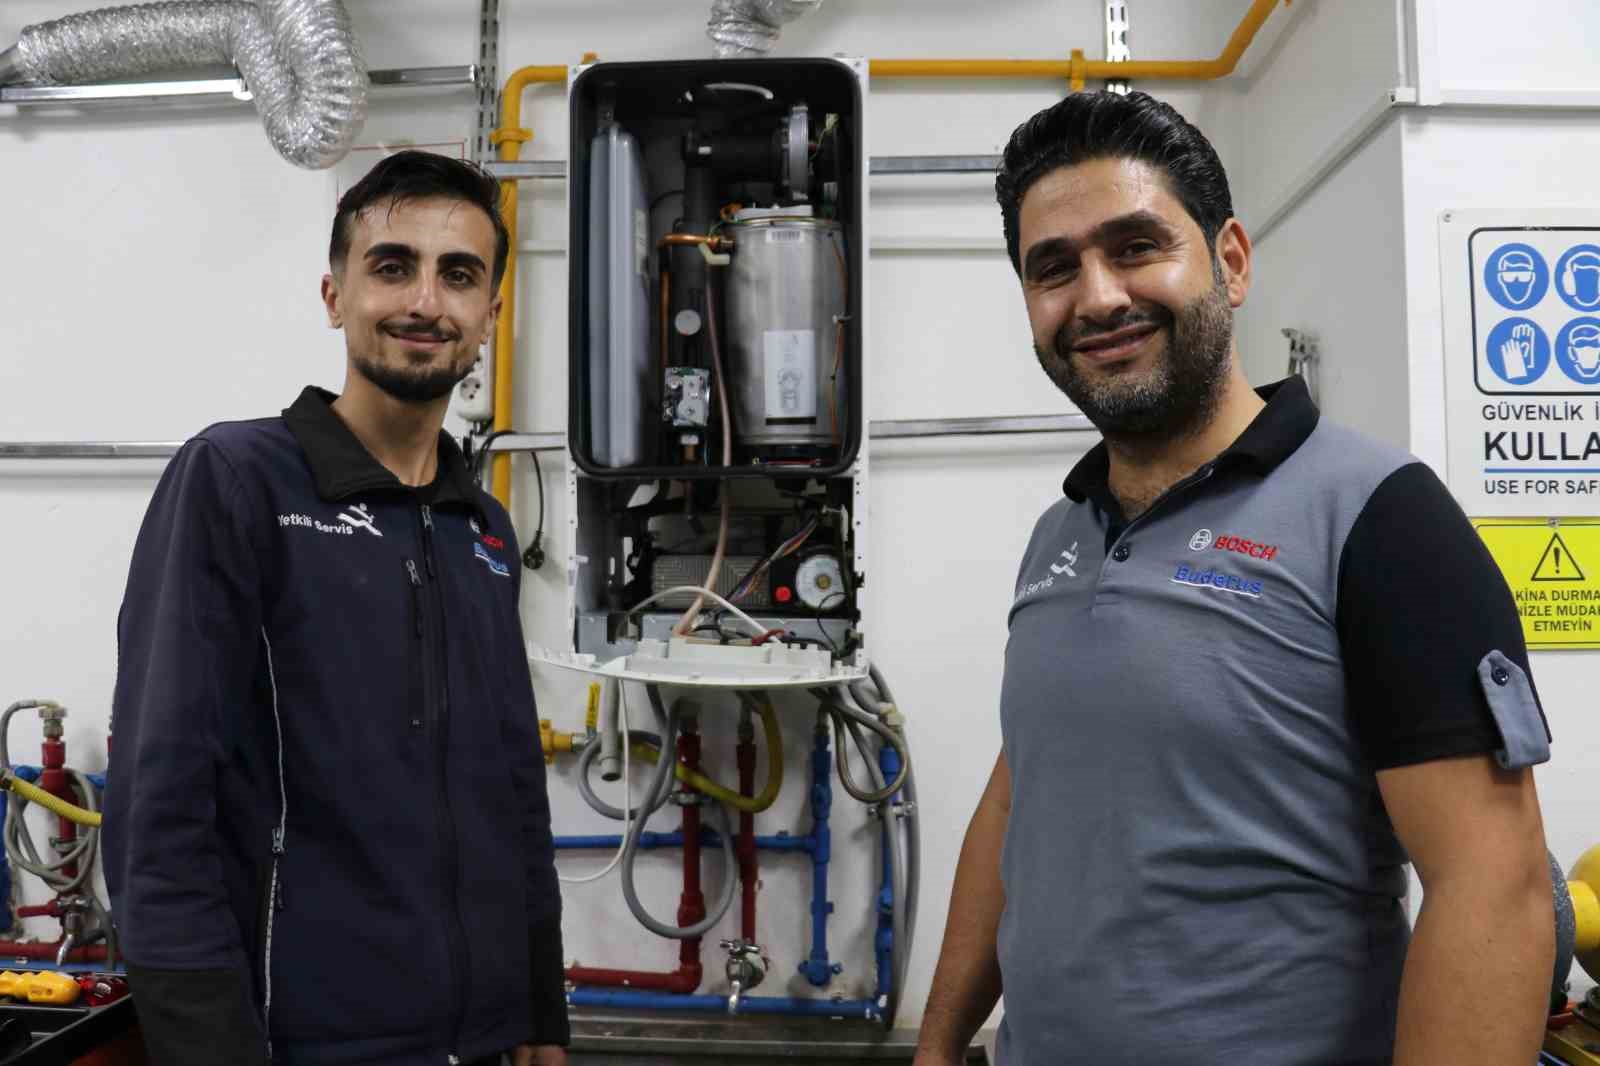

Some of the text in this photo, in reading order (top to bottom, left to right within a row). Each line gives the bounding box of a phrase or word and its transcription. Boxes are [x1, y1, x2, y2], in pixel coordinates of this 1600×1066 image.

[1482, 400, 1584, 421] GÜVENLİK
[1484, 431, 1600, 461] KULLA
[1484, 479, 1519, 494] USE
[1524, 479, 1560, 494] FOR
[314, 519, 353, 535] Servis
[1214, 536, 1277, 561] BOSCH
[1175, 563, 1263, 593] Buderus
[1556, 602, 1600, 617] MÜDA
[1534, 617, 1592, 632] ETMEYİN
